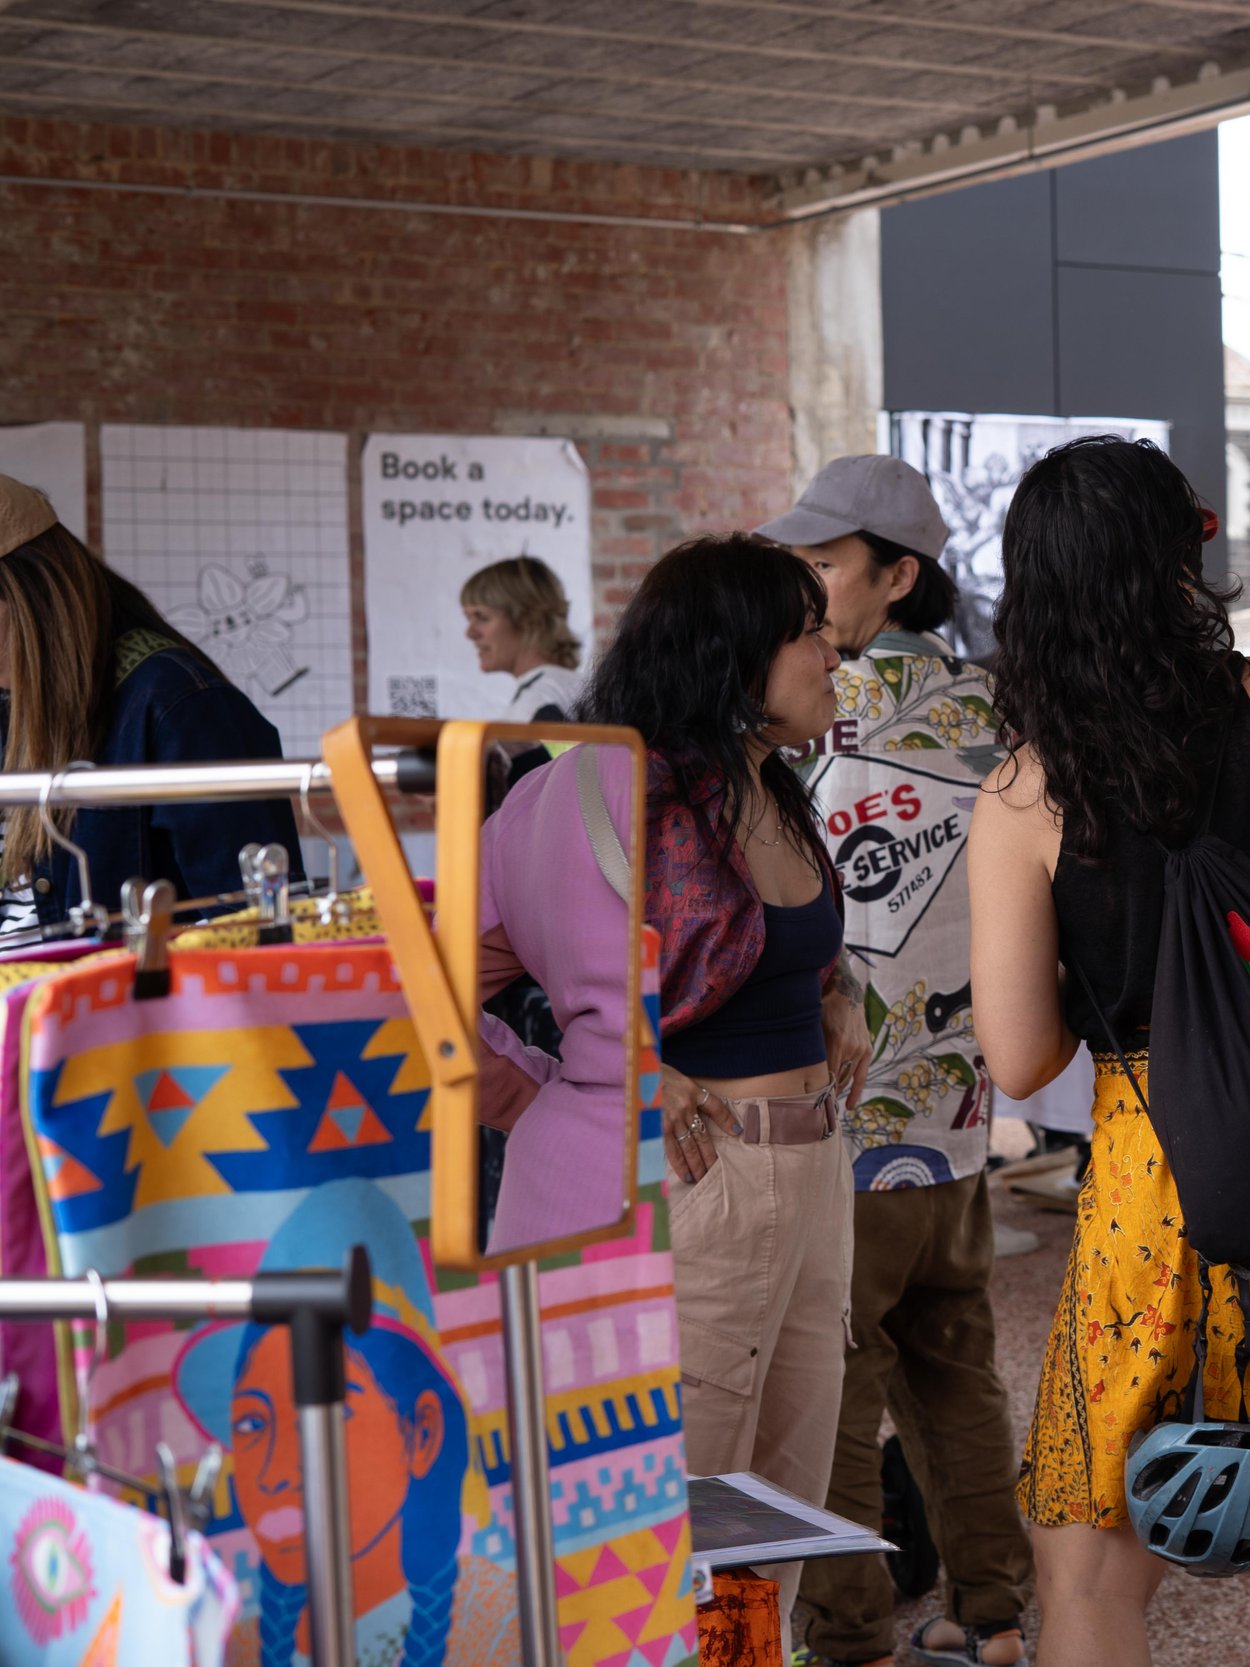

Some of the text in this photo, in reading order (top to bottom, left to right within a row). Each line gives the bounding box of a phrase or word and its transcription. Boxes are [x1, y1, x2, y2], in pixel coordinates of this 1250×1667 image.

[381, 453, 485, 480] Book a
[381, 496, 575, 528] space today.
[823, 783, 922, 837] OE'S
[852, 813, 962, 882] SERVICE
[887, 865, 934, 914] 577482
